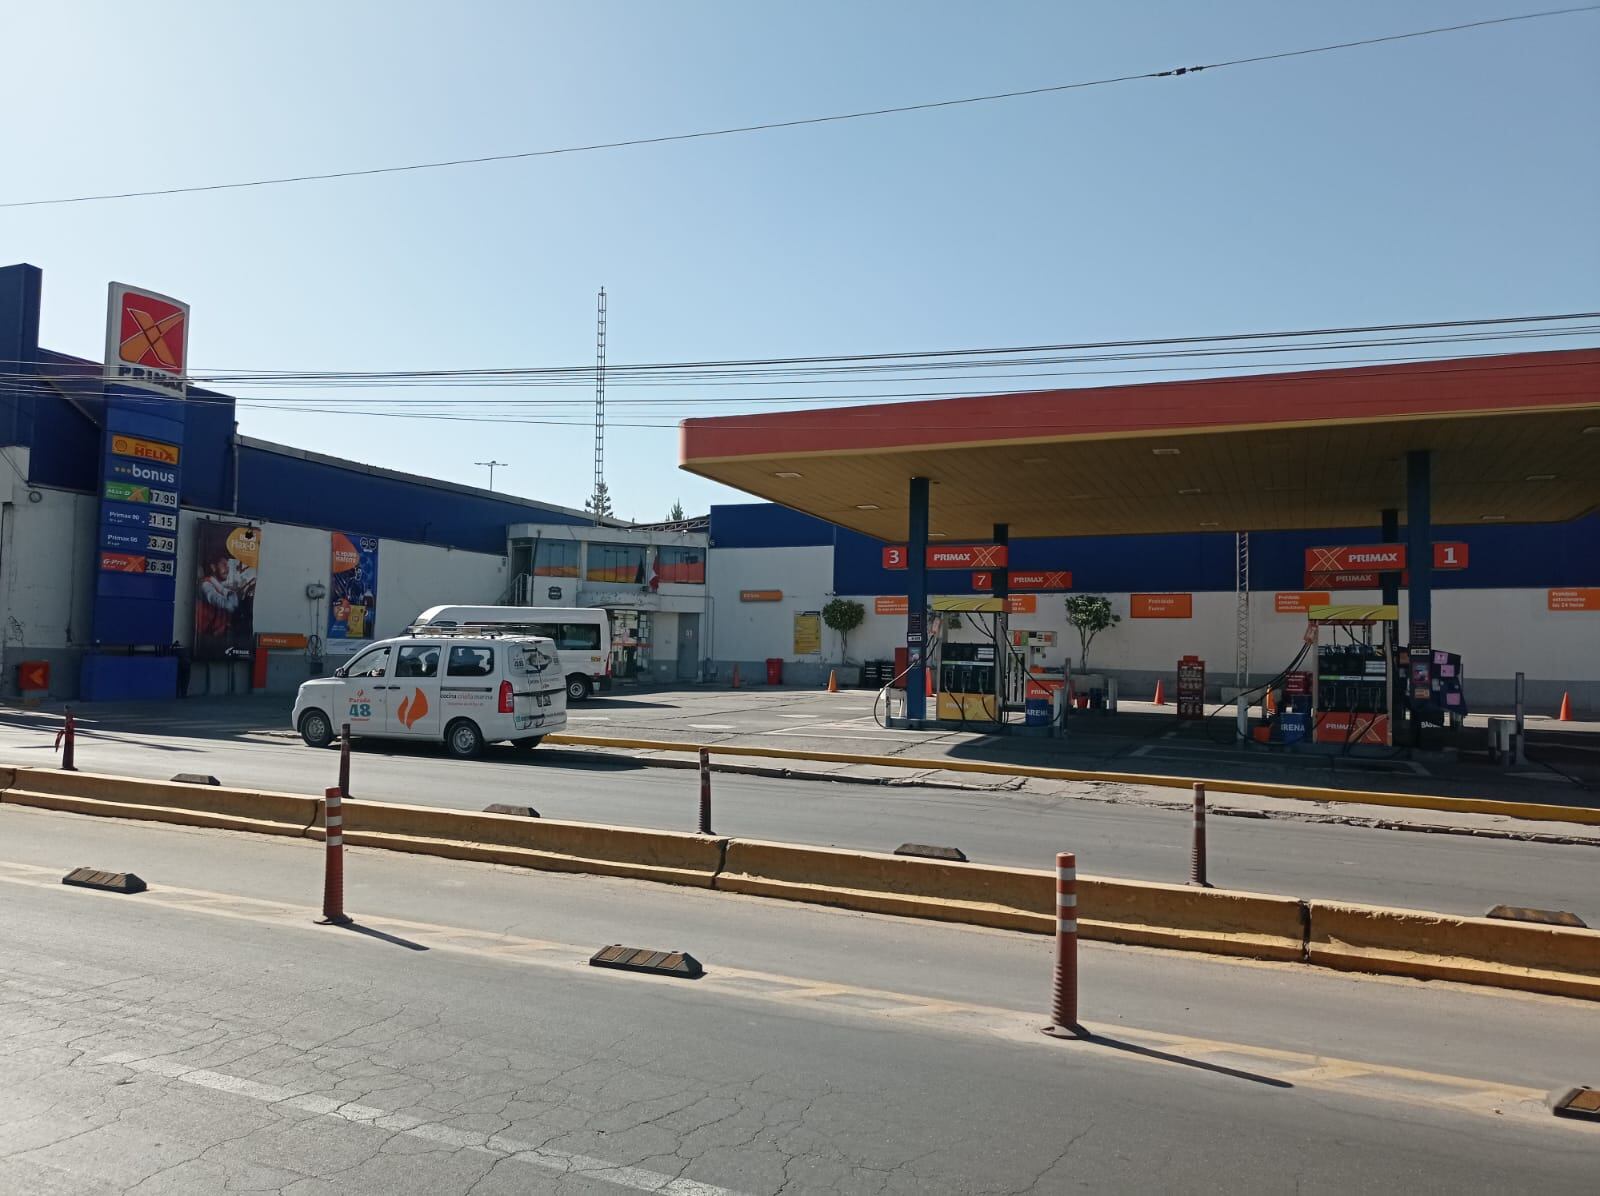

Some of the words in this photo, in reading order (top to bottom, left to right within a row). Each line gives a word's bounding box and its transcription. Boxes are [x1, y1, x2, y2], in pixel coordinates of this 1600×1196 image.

[134, 446, 176, 462] HELIX
[132, 463, 175, 483] bonus
[888, 549, 900, 564] 3
[933, 553, 971, 561] PRIMAX
[1347, 552, 1398, 563] PRIMAX
[1443, 547, 1458, 564] 1
[977, 575, 986, 586] 7
[1335, 573, 1372, 582] PRIMAX
[349, 703, 371, 718] 48
